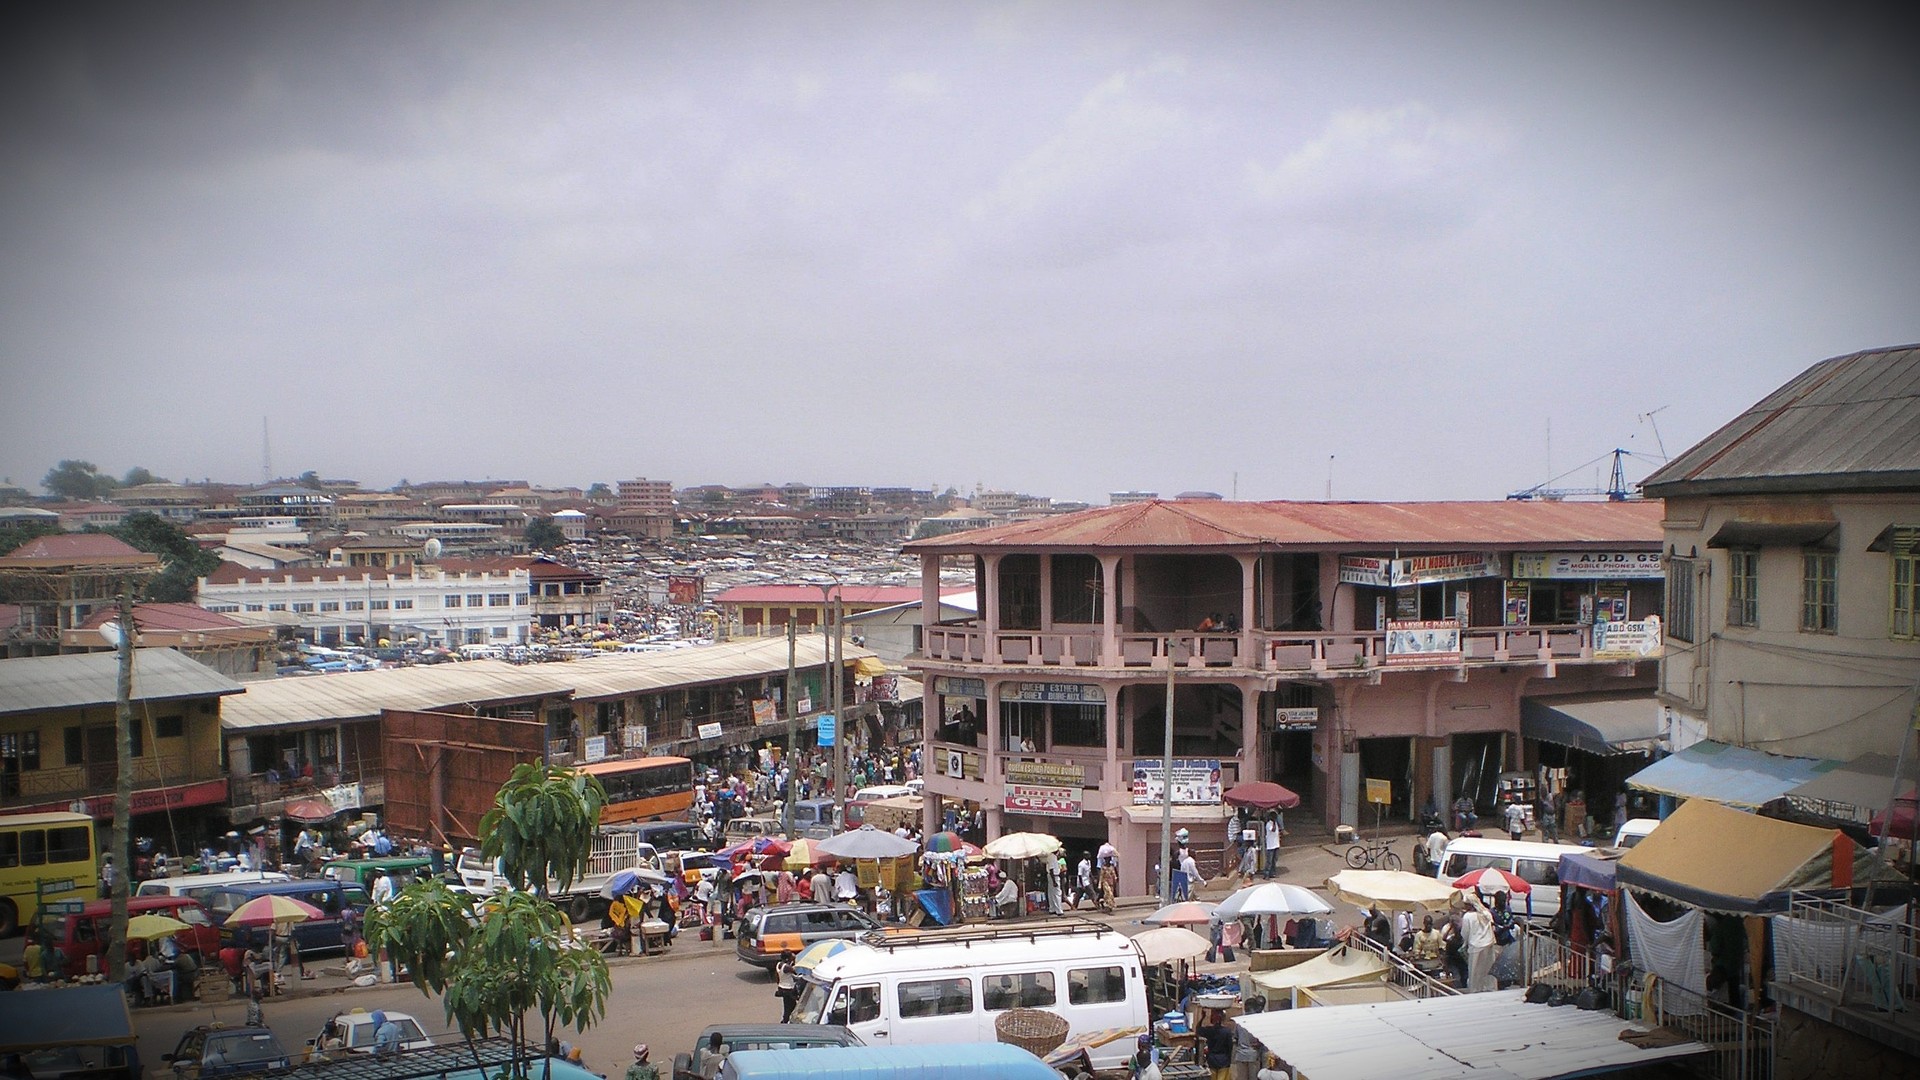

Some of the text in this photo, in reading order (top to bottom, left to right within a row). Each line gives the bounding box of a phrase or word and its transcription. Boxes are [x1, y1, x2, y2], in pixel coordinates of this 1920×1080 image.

[1429, 555, 1454, 569] MOBILE
[1457, 552, 1483, 566] PHONES
[1580, 553, 1660, 563] A.D.D. GS
[1387, 620, 1460, 630] PAA MOBILE PHONES
[1627, 624, 1645, 632] GSM
[1021, 683, 1078, 692] QUEEN ESTHER
[1020, 691, 1080, 701] FOREX BUREAUX
[1015, 786, 1072, 798] PIRELLI
[1014, 797, 1071, 809] CEAT
